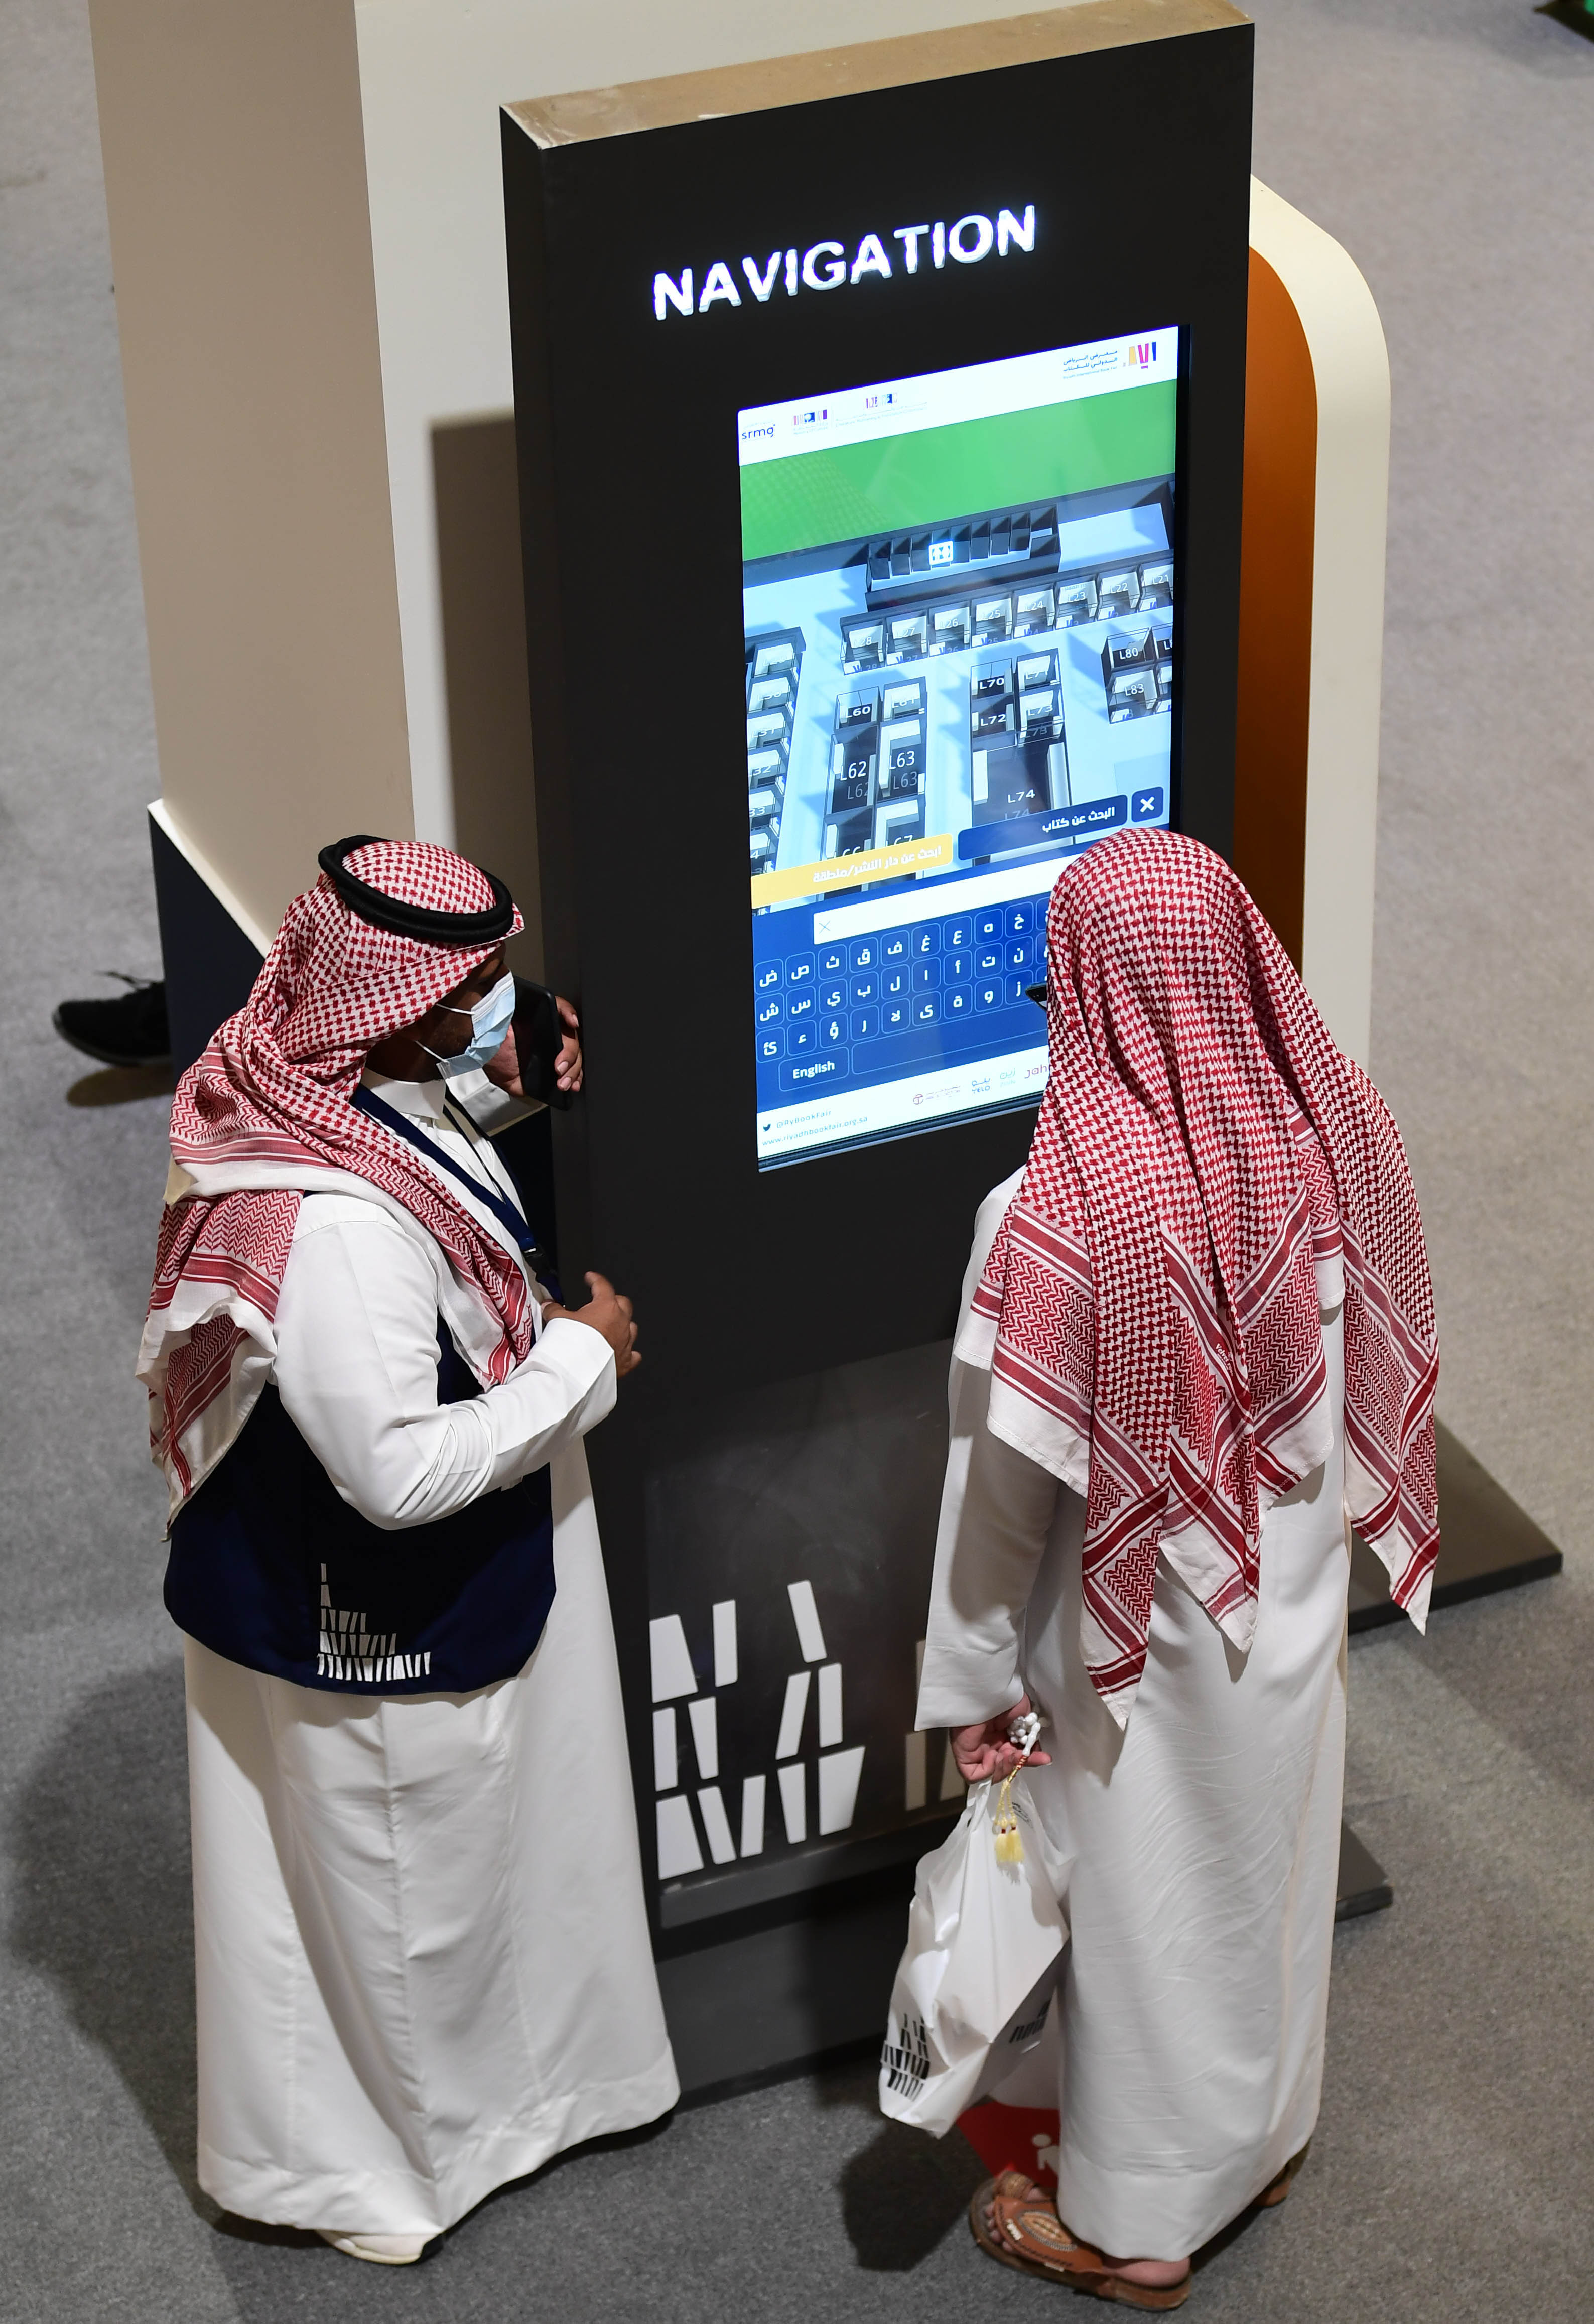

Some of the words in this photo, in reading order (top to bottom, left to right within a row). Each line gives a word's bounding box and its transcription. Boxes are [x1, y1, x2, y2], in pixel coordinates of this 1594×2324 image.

[654, 205, 1035, 320] NAVIGATION
[1152, 574, 1169, 585] L21
[1110, 583, 1128, 594] L22
[1119, 648, 1139, 660] L80
[979, 678, 1005, 690] L70
[1125, 683, 1144, 696] L83
[846, 706, 871, 718] L60
[980, 714, 1007, 726] L72
[889, 750, 915, 770] L63
[840, 761, 867, 781] L62
[893, 771, 917, 790] L63
[1008, 789, 1035, 803] L74
[1072, 815, 1086, 826] عن
[1088, 806, 1115, 821] البحث
[1042, 818, 1070, 833] كتاب
[884, 855, 899, 869] دار
[901, 853, 915, 864] عن
[1014, 914, 1024, 930] خ
[921, 935, 931, 952] غ
[953, 930, 962, 945] ع
[887, 941, 902, 955] ف
[1014, 948, 1023, 963] ن
[826, 955, 839, 969] ث
[857, 948, 870, 965] ق
[982, 956, 995, 967] ت
[759, 970, 777, 987] ض
[791, 965, 809, 980] ص
[857, 985, 871, 997] ب
[890, 976, 900, 991] ل
[1016, 981, 1021, 996] ز
[827, 991, 840, 1007] ي
[953, 995, 962, 1008] ة
[984, 991, 993, 1003] و
[760, 1003, 779, 1021] ش
[791, 999, 811, 1014] س
[830, 1021, 839, 1040] ؤ
[862, 1020, 866, 1032] ر
[798, 1034, 806, 1043] ء
[793, 1061, 835, 1079] English
